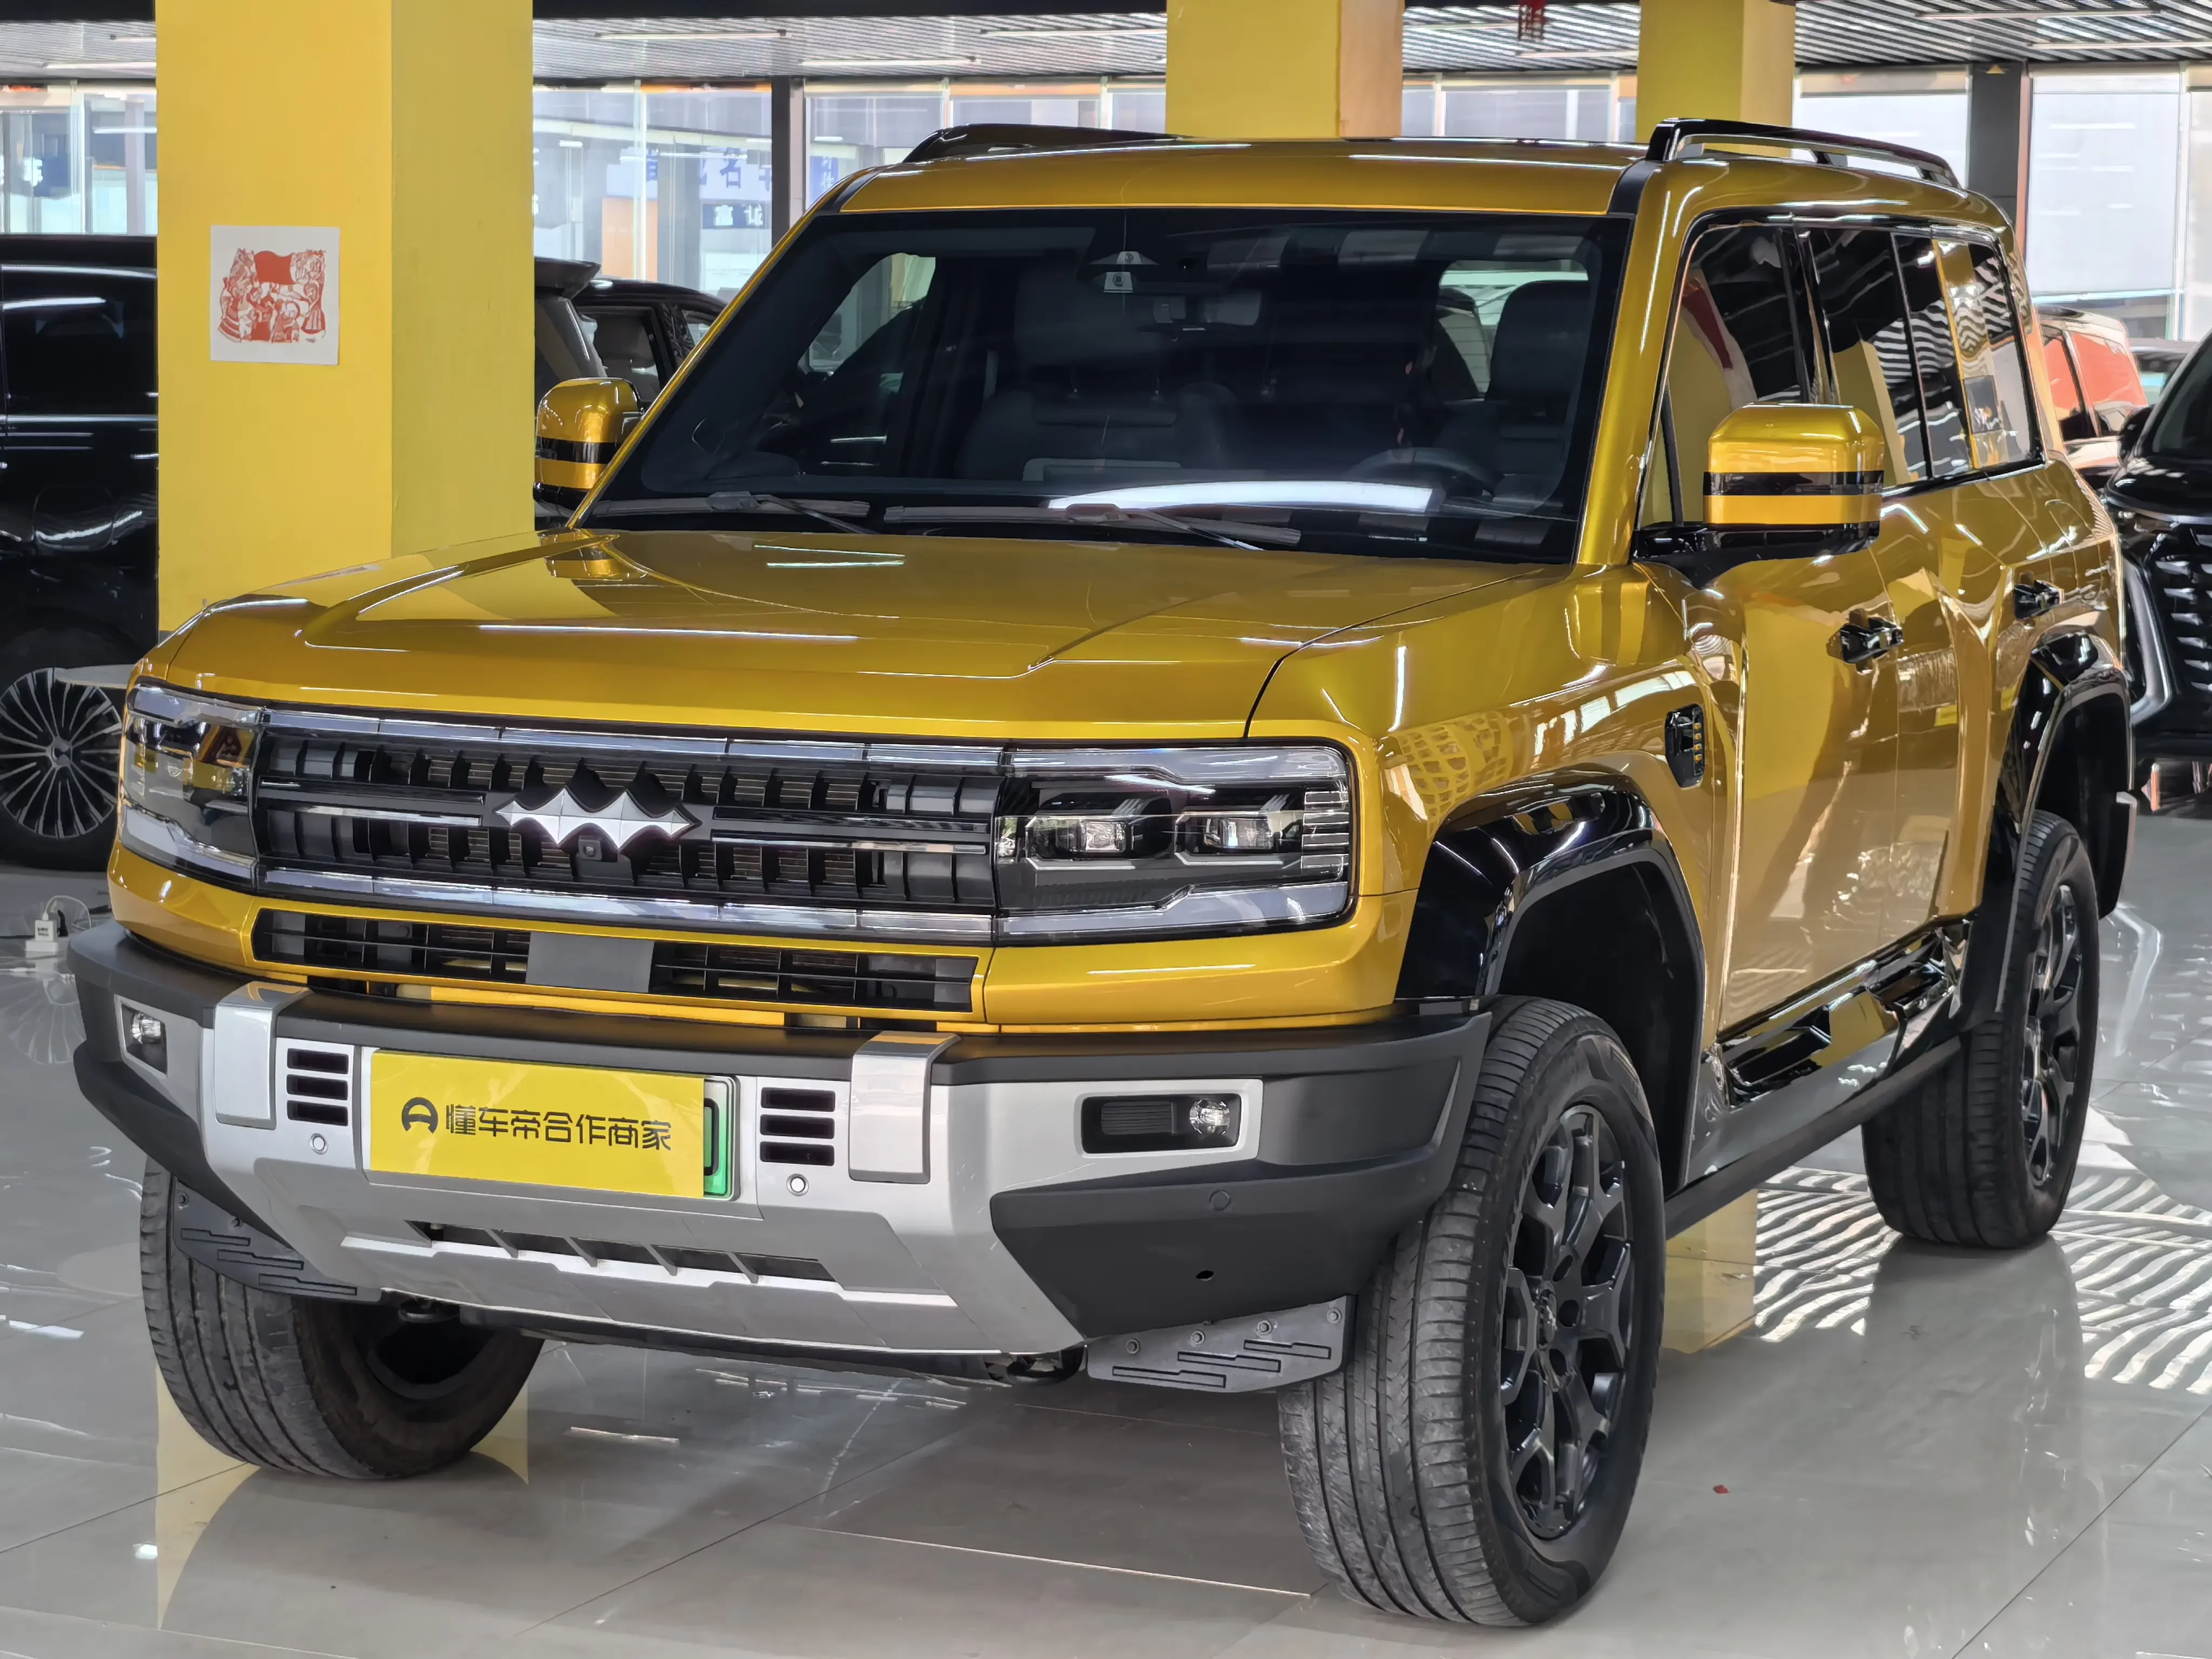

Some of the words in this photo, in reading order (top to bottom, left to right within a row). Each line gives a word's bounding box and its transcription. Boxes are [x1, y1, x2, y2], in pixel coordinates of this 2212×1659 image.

[446, 1104, 672, 1150] 懂车帝合作商家
